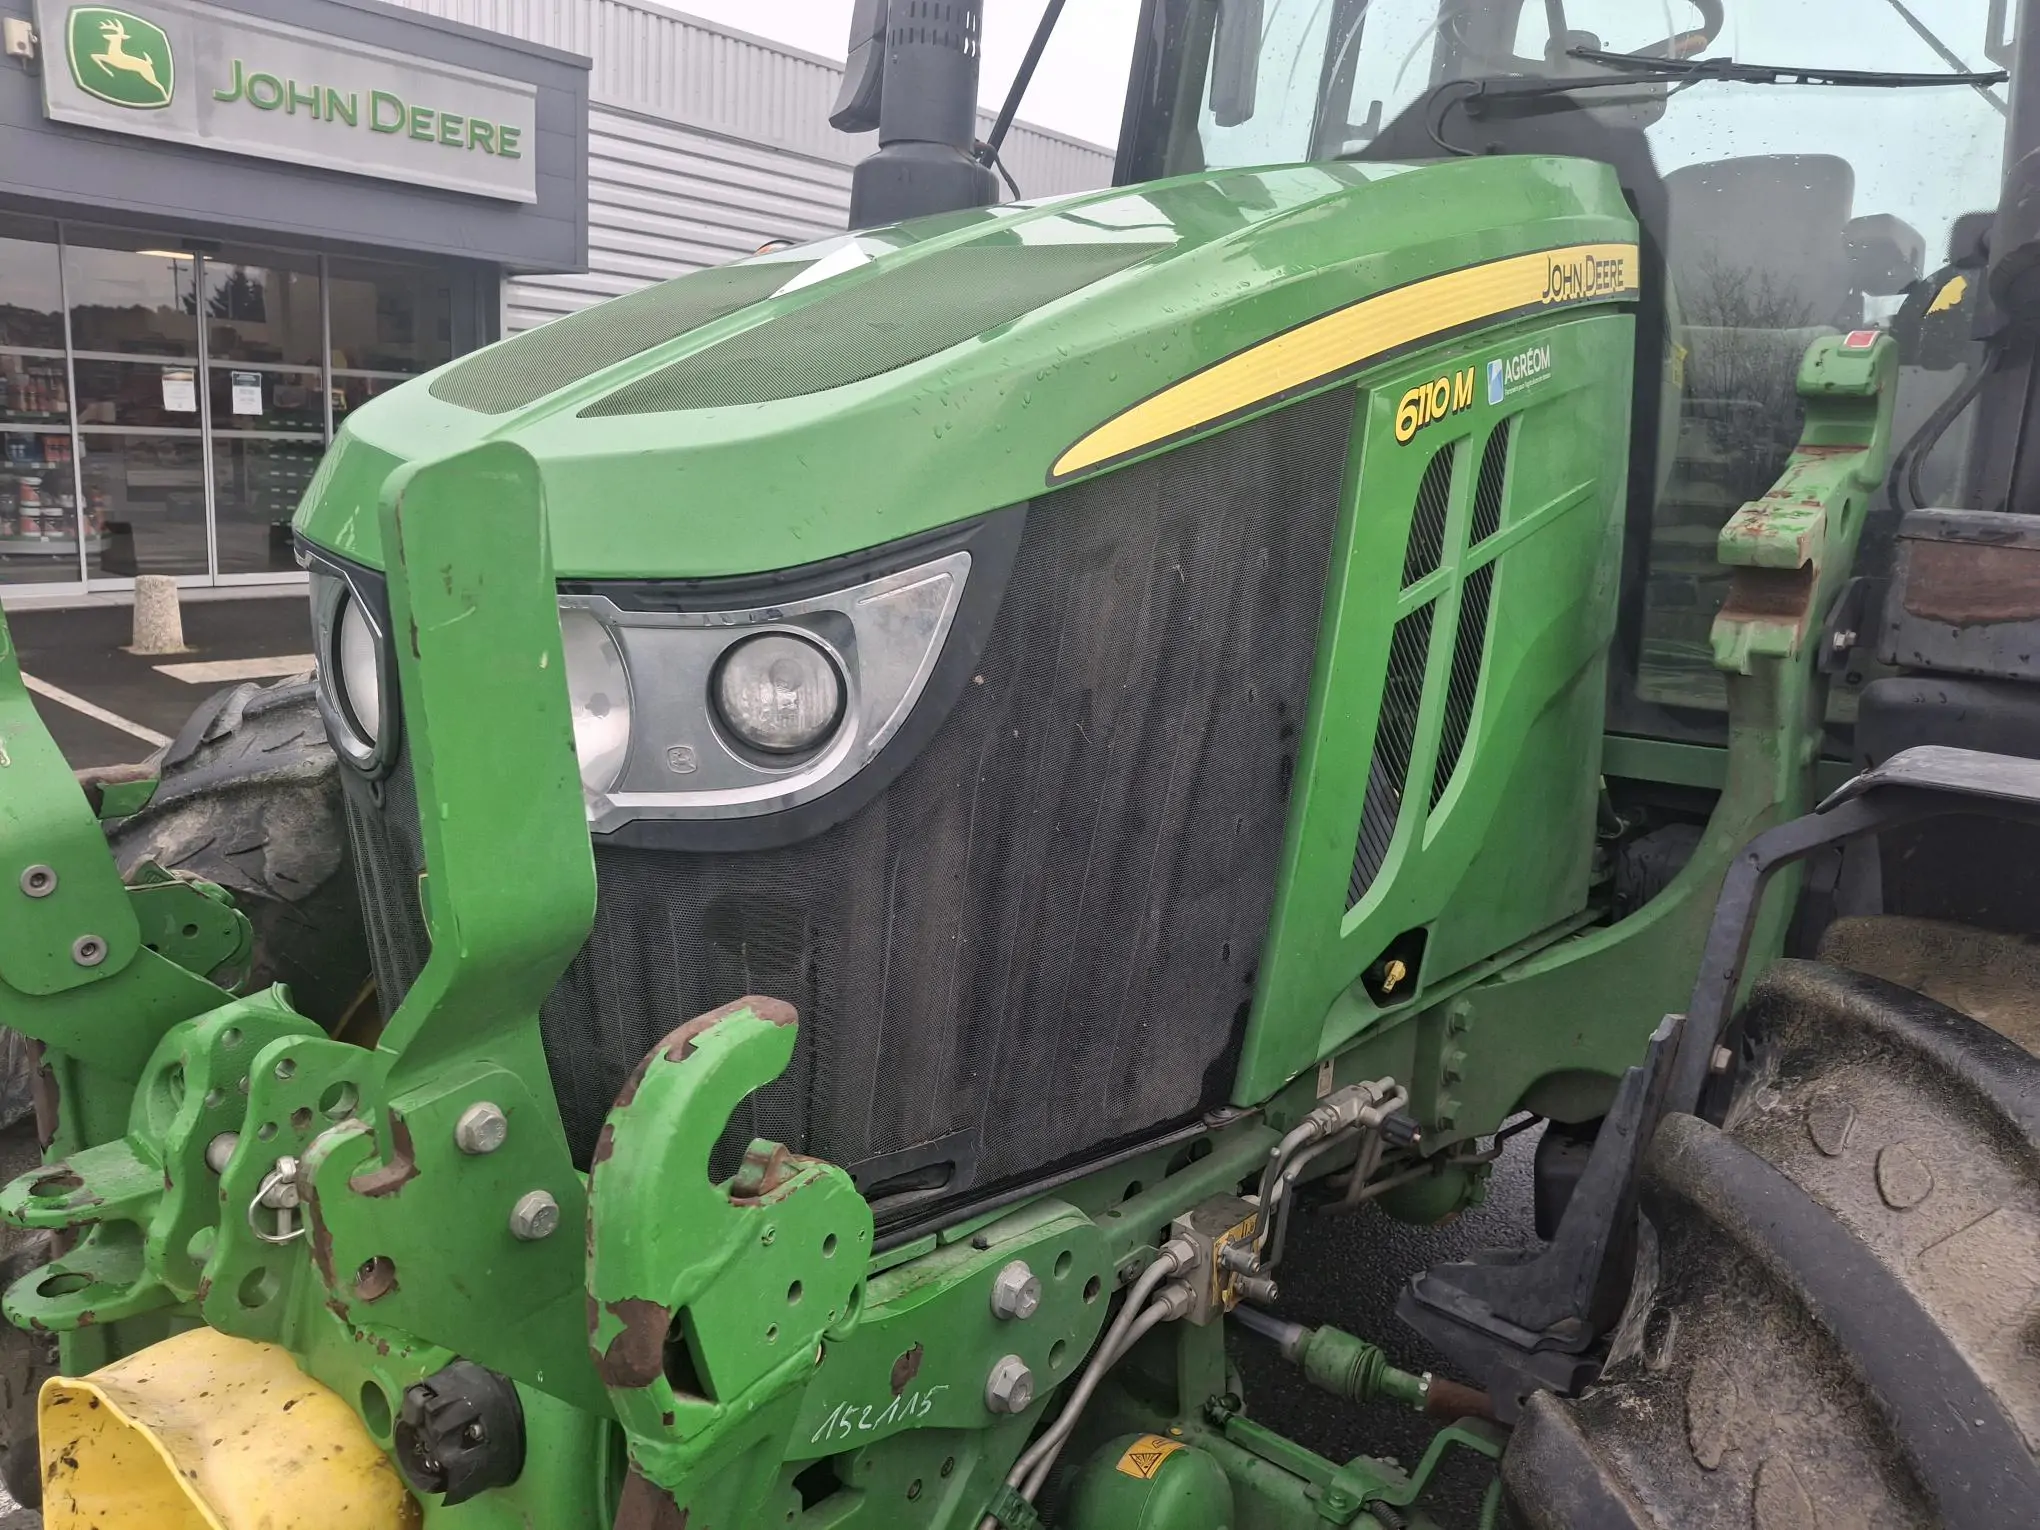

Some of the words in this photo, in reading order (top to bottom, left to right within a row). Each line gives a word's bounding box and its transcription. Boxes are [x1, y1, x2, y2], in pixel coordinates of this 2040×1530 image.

[213, 60, 358, 127] JOHN
[369, 90, 521, 158] DEERE
[1542, 256, 1582, 298] JOHN
[1586, 255, 1623, 291] DEERE
